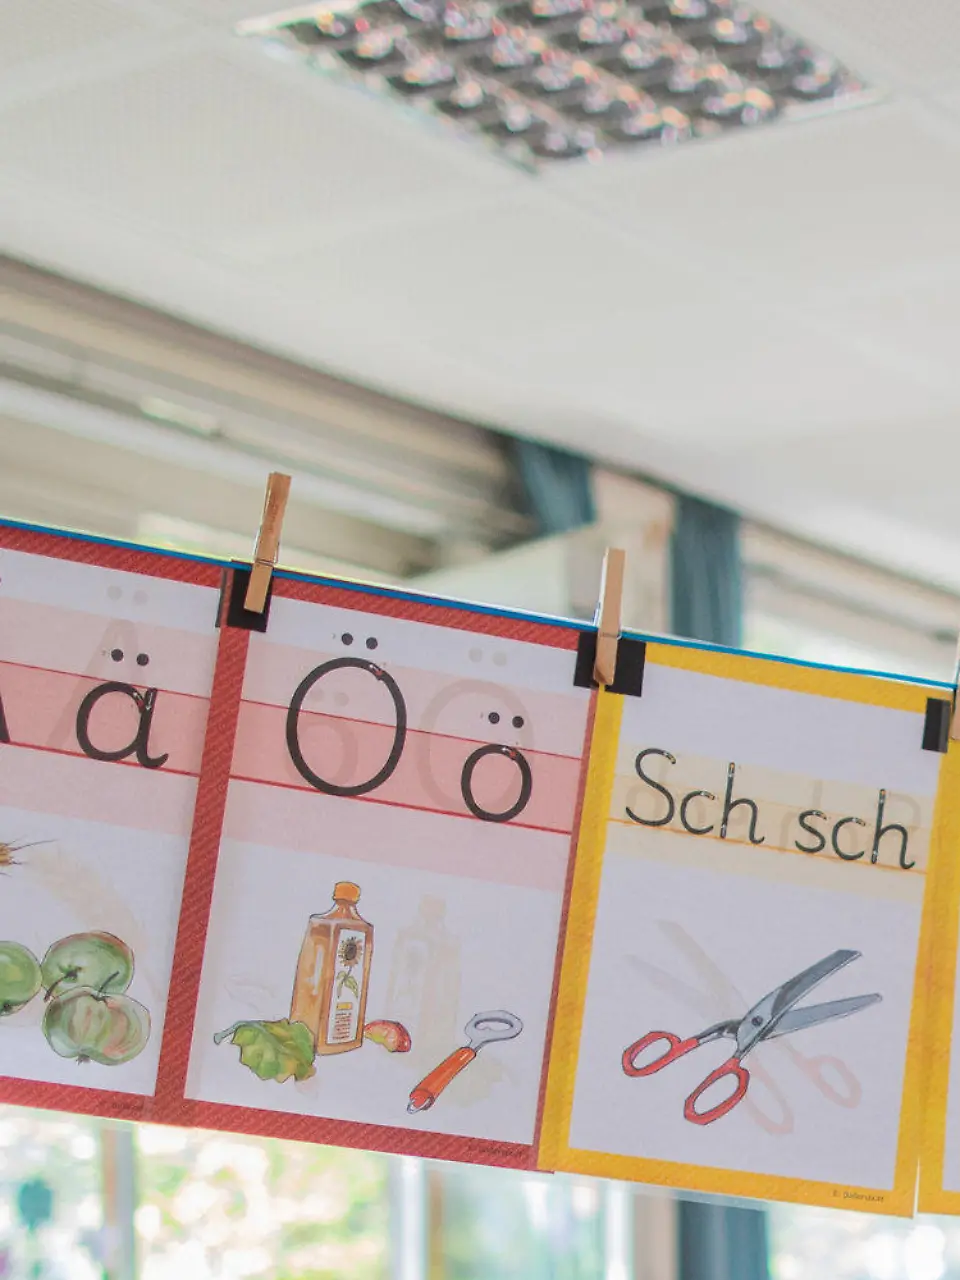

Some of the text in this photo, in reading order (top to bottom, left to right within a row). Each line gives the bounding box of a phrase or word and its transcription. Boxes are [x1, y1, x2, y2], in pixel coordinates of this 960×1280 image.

[286, 632, 532, 823] Ö ö
[625, 748, 915, 870] Sch sch
